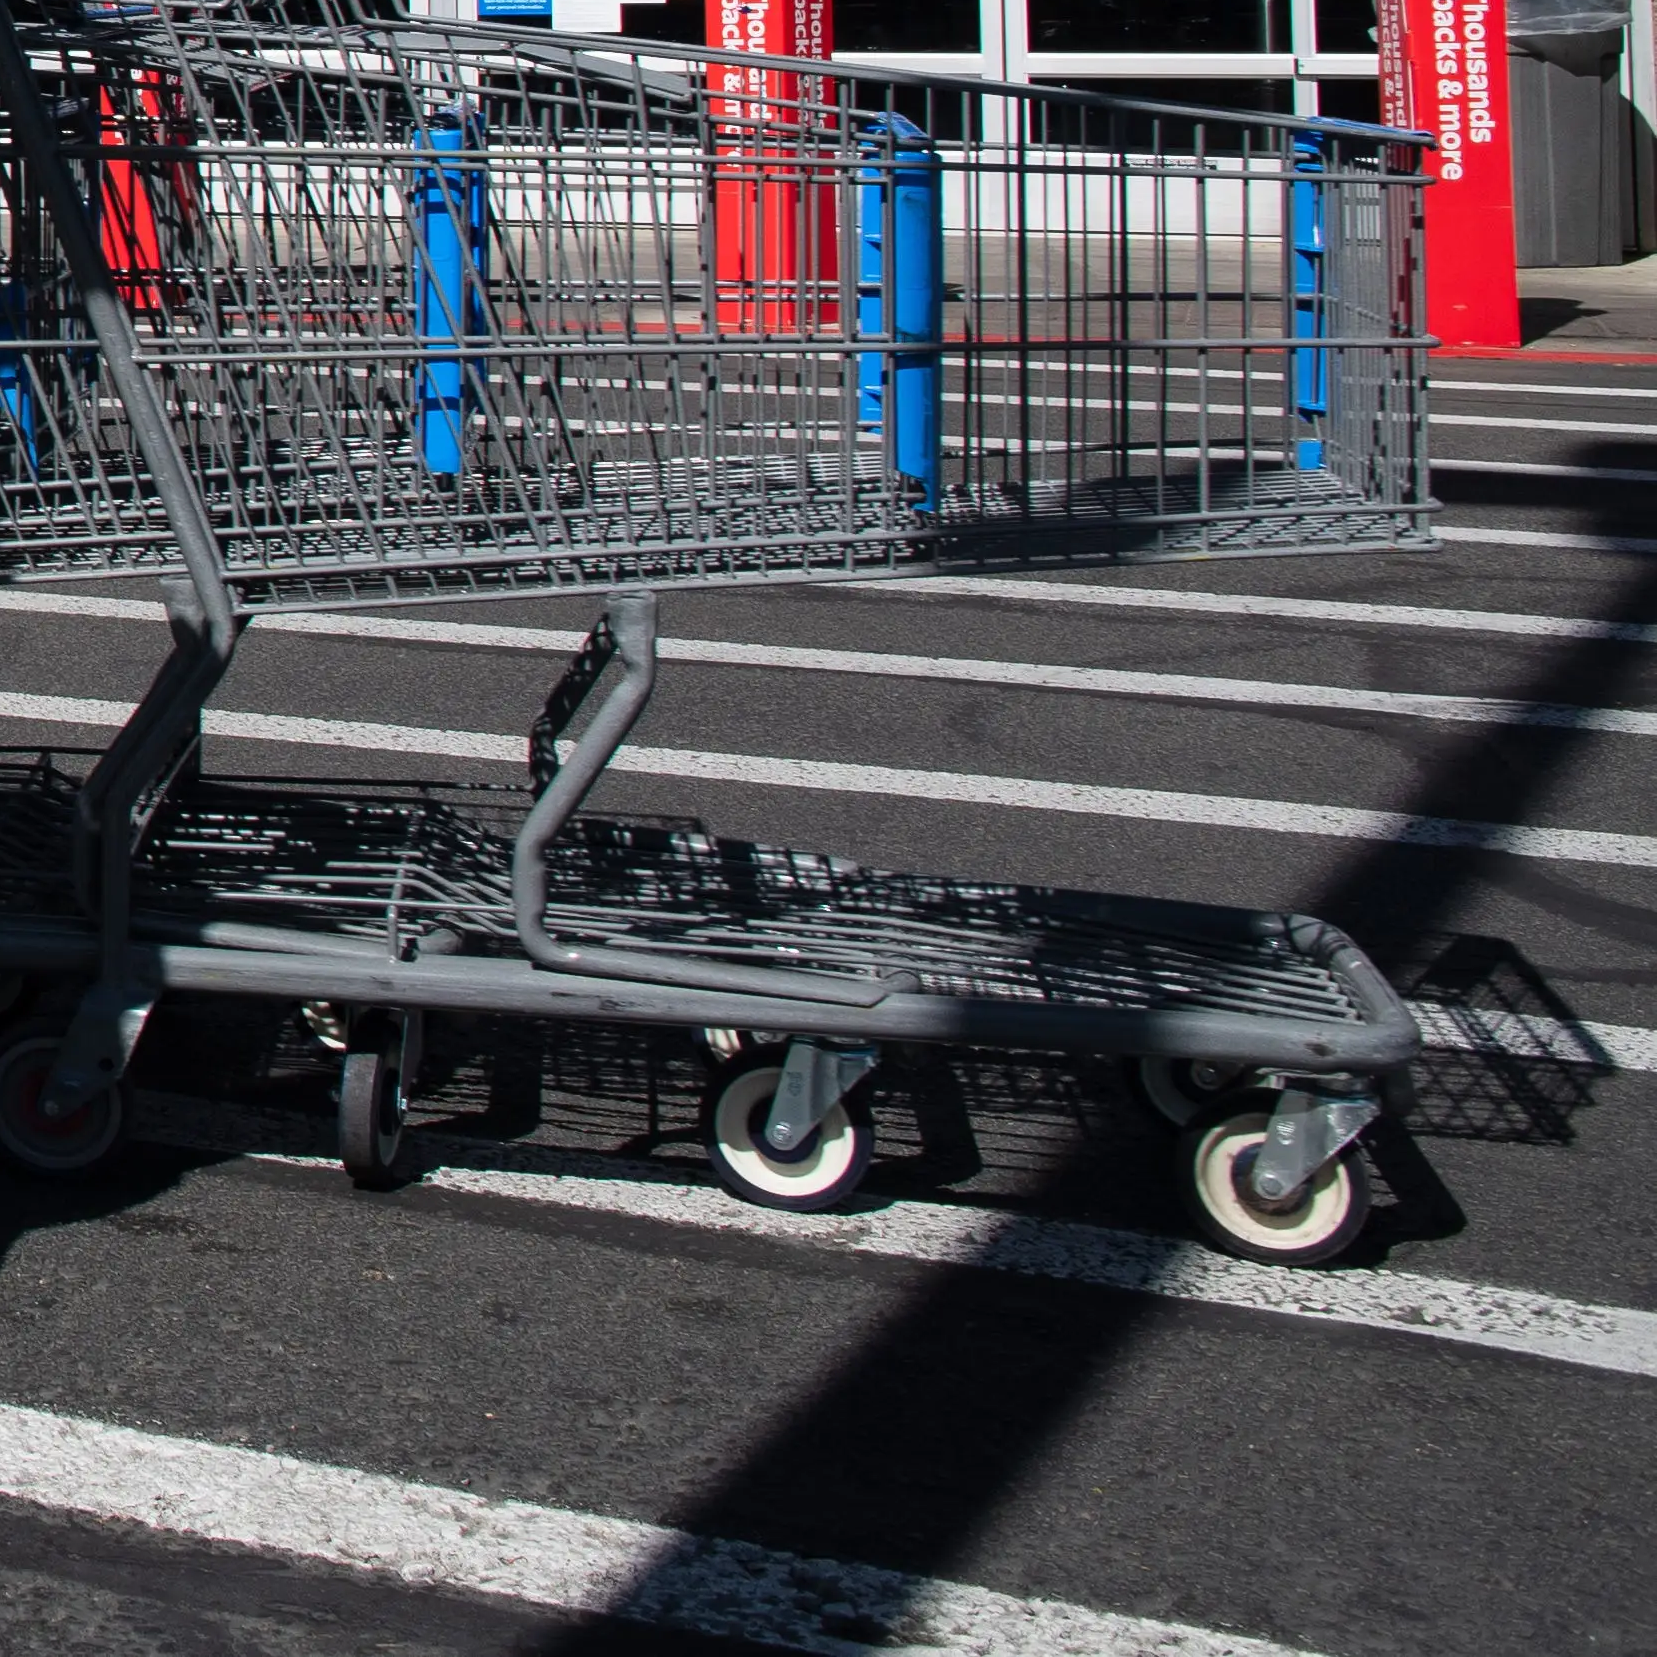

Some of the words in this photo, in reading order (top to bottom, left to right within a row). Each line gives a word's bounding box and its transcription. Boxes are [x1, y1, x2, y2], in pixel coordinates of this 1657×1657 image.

[1437, 79, 1463, 99] &
[725, 98, 745, 168] moe
[1438, 104, 1465, 180] more
